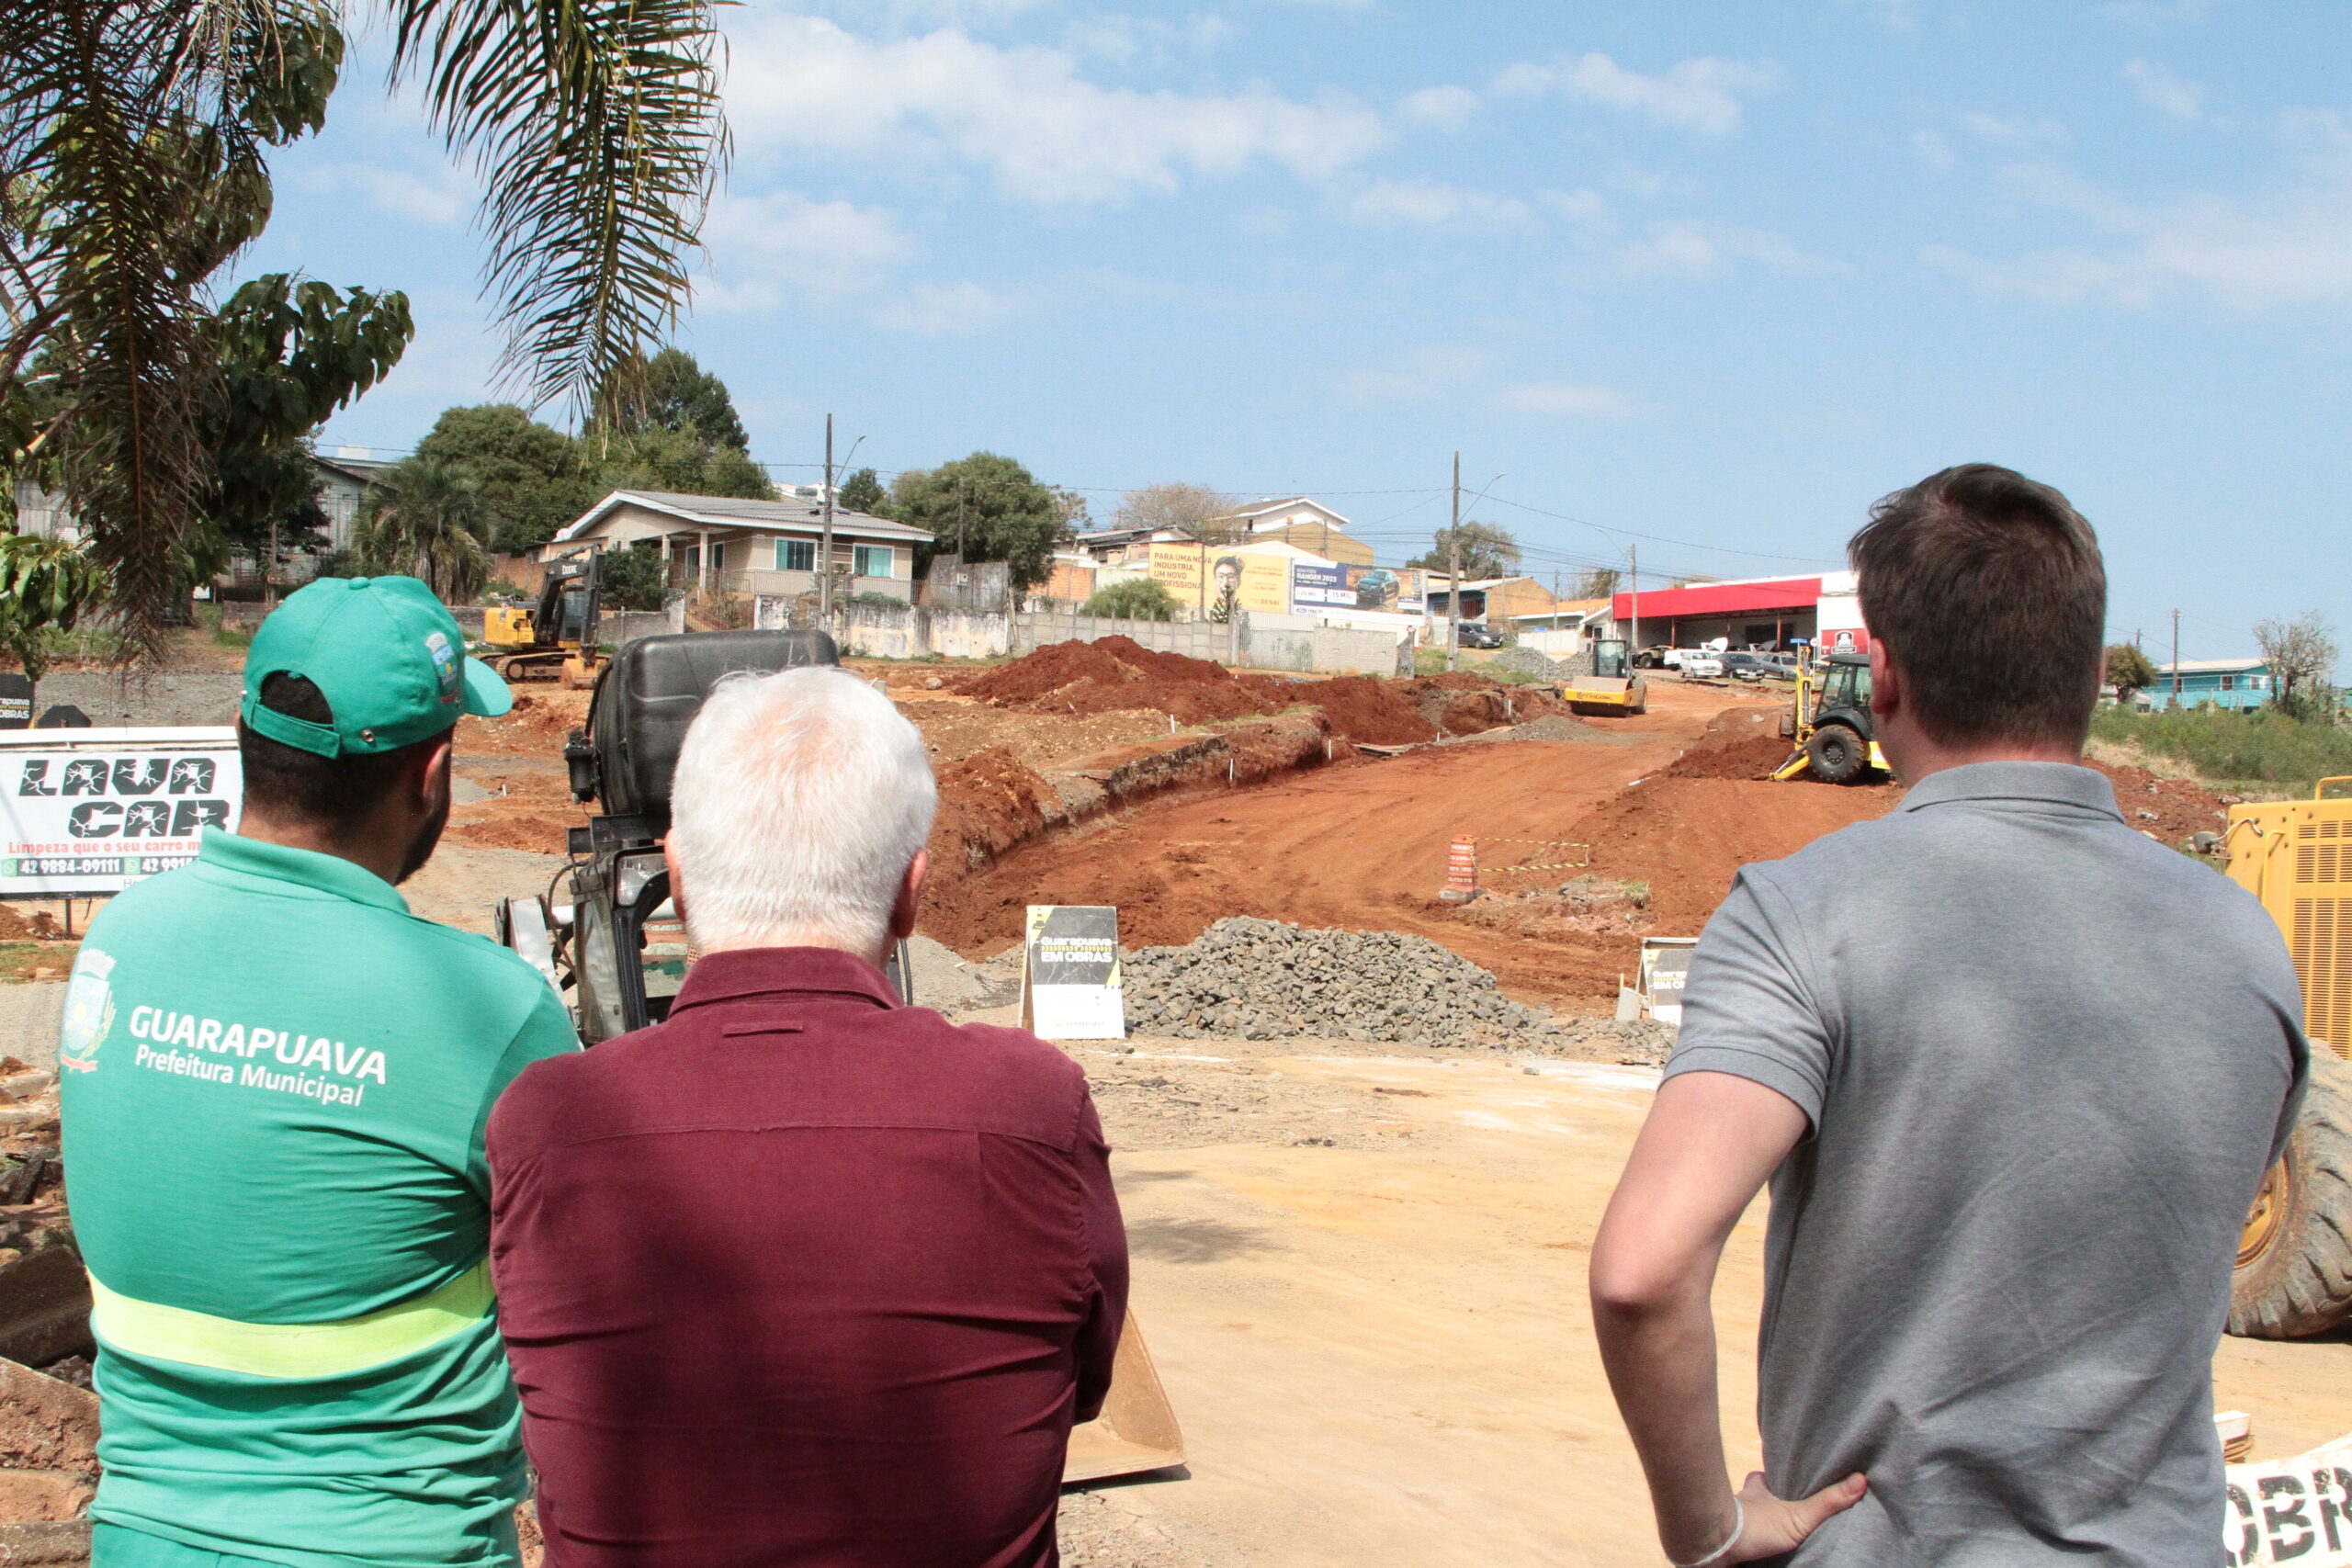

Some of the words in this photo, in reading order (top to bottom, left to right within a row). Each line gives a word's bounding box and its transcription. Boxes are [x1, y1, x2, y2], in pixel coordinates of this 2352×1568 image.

[1154, 552, 1174, 560] PARA
[1175, 554, 1192, 562] UMA
[1296, 572, 1321, 581] RANGER
[1322, 574, 1337, 582] 2023
[1154, 580, 1205, 590] PROFISSIONA
[0, 709, 29, 719] OBRAS
[18, 758, 217, 796] LAVA
[68, 800, 230, 838] CAR
[8, 841, 69, 855] Limpeza
[74, 843, 100, 855] que
[104, 844, 111, 852] o
[116, 842, 141, 852] seu
[144, 841, 183, 852] carro
[20, 860, 39, 874] 42
[41, 858, 120, 874] 9884-09111
[141, 858, 159, 872] 42
[1041, 937, 1112, 947] Guarapuava
[1041, 952, 1064, 962] EM
[1065, 952, 1113, 963] OBRAS
[1654, 981, 1671, 989] EM
[129, 1006, 387, 1085] GUARAPUAVA
[135, 1043, 234, 1084] Prefeitura
[239, 1064, 365, 1108] Municipal
